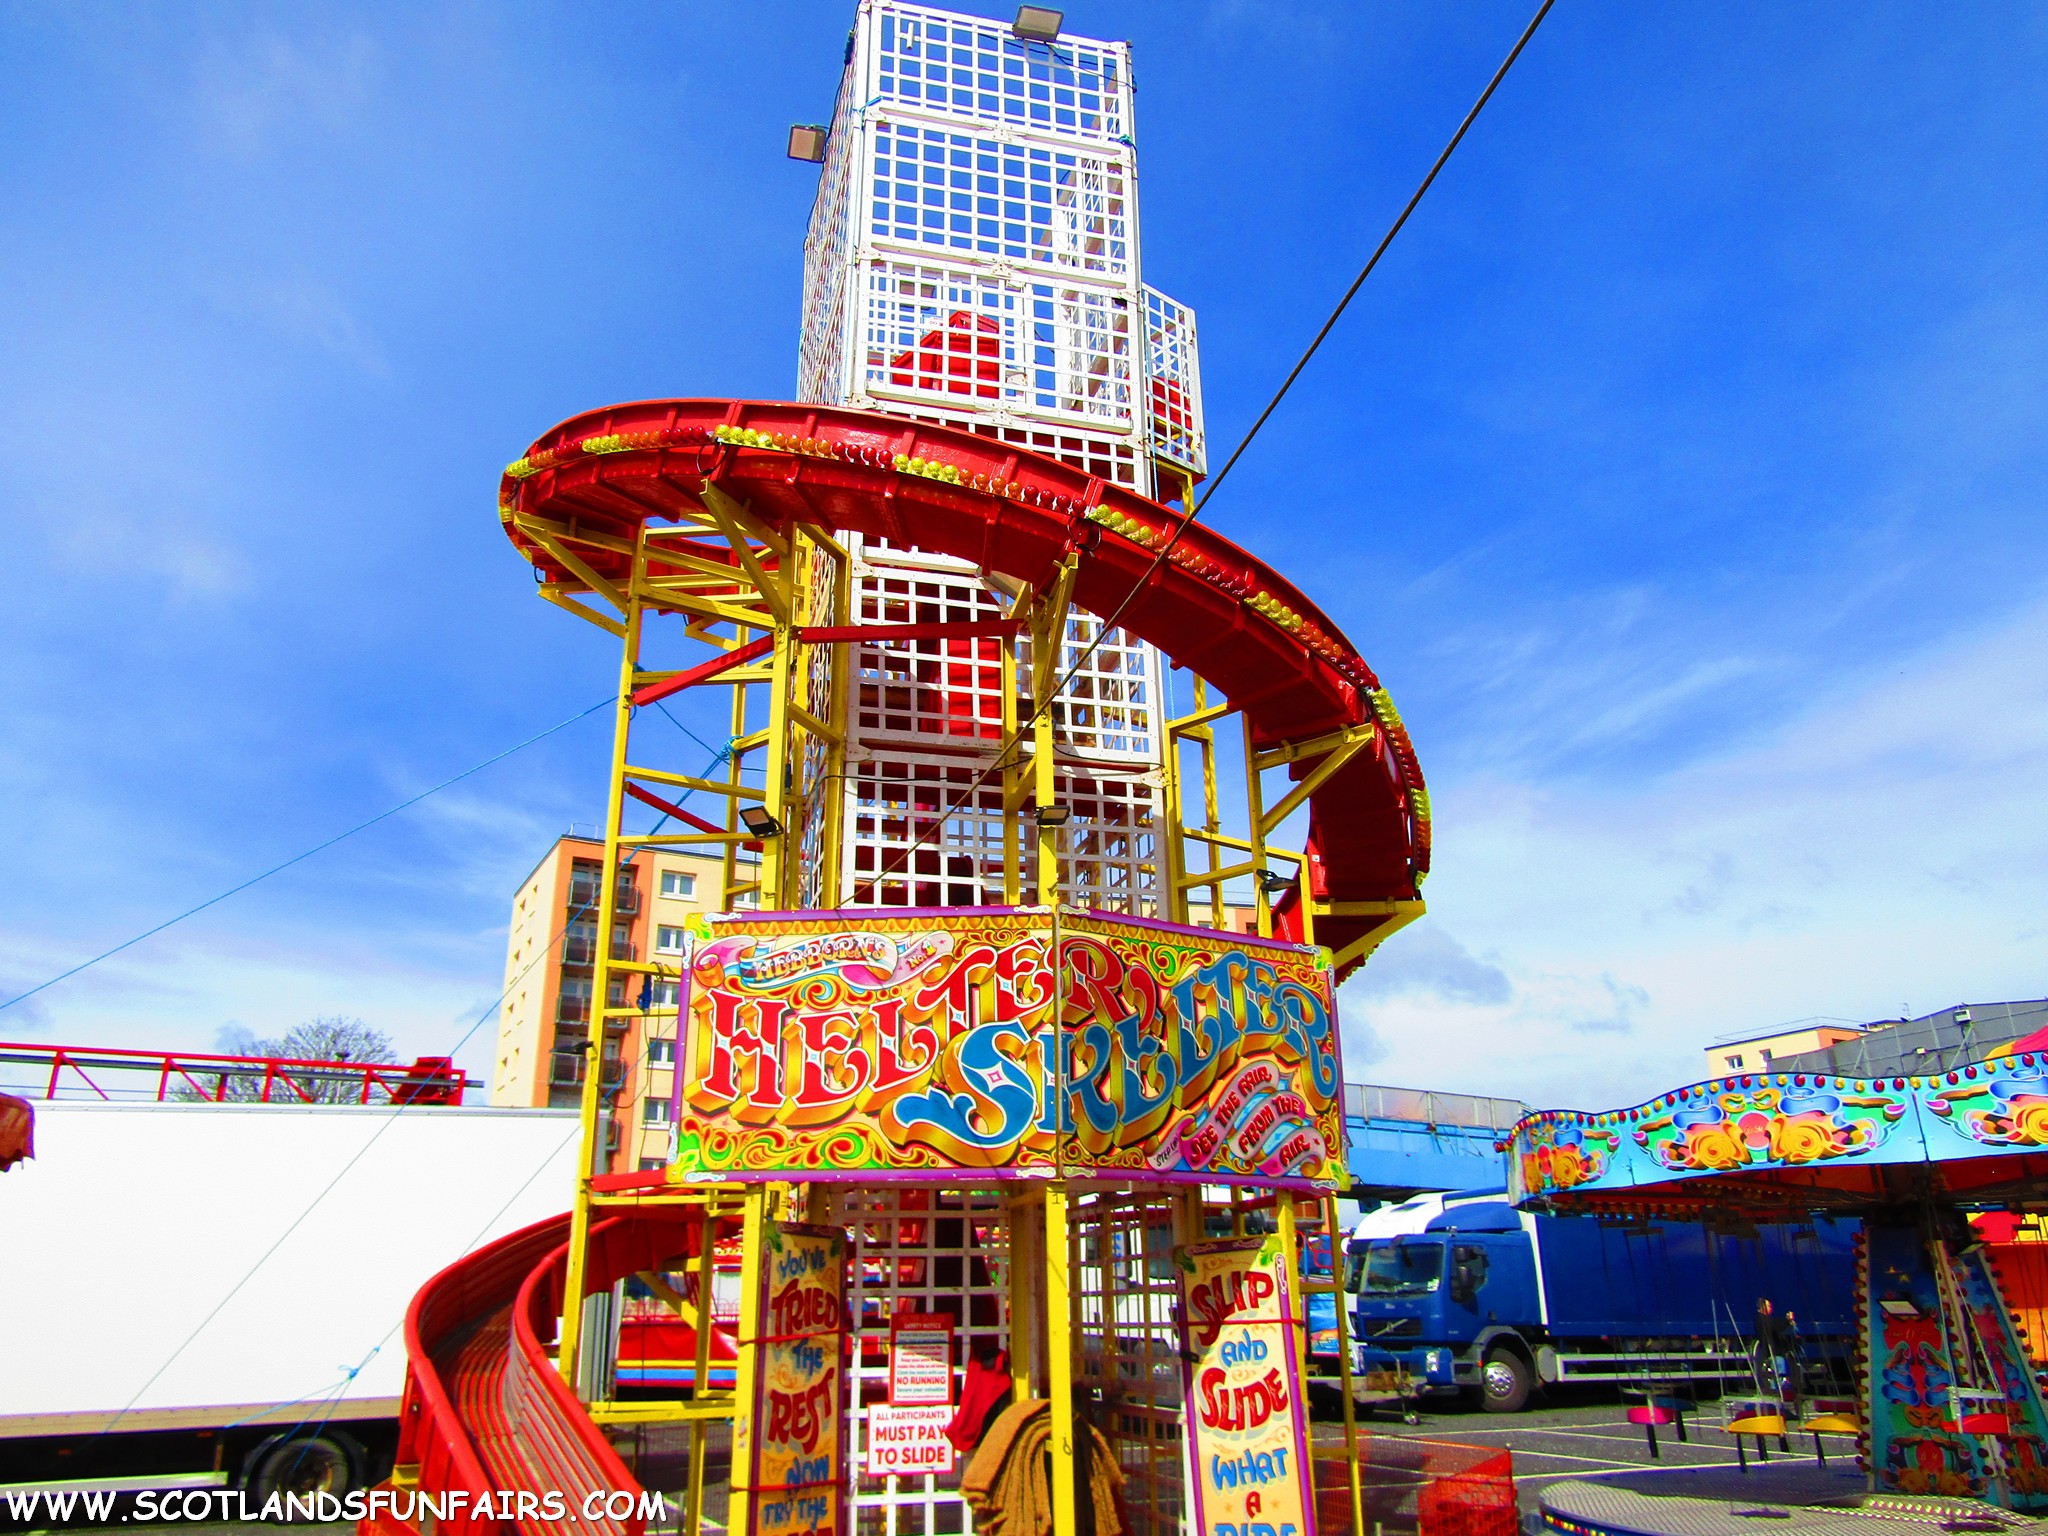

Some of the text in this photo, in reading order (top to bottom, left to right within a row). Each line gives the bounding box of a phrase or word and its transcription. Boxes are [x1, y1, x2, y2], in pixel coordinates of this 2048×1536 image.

[695, 934, 1162, 1114] HELTER
[892, 950, 1337, 1144] SKELTER
[1189, 1064, 1272, 1163] SEE THE FAIR
[1238, 1094, 1300, 1155] FROM THE
[1279, 1132, 1311, 1167] AIR
[780, 1245, 826, 1279] YOU'VE
[771, 1278, 839, 1349] TRIED
[1191, 1271, 1274, 1347] SLIP
[792, 1337, 824, 1377] THE
[1220, 1328, 1269, 1368] AND
[897, 1376, 946, 1385] NO RUNNING
[1200, 1367, 1288, 1432] SLIDE
[767, 1367, 835, 1456] REST
[876, 1410, 946, 1421] ALL PARTICIPANTS
[875, 1424, 946, 1442] MUST PAY
[875, 1446, 946, 1465] TO SLIDE
[1212, 1447, 1289, 1491] WHAT
[764, 1496, 829, 1531] TRY THE
[1245, 1490, 1262, 1519] A
